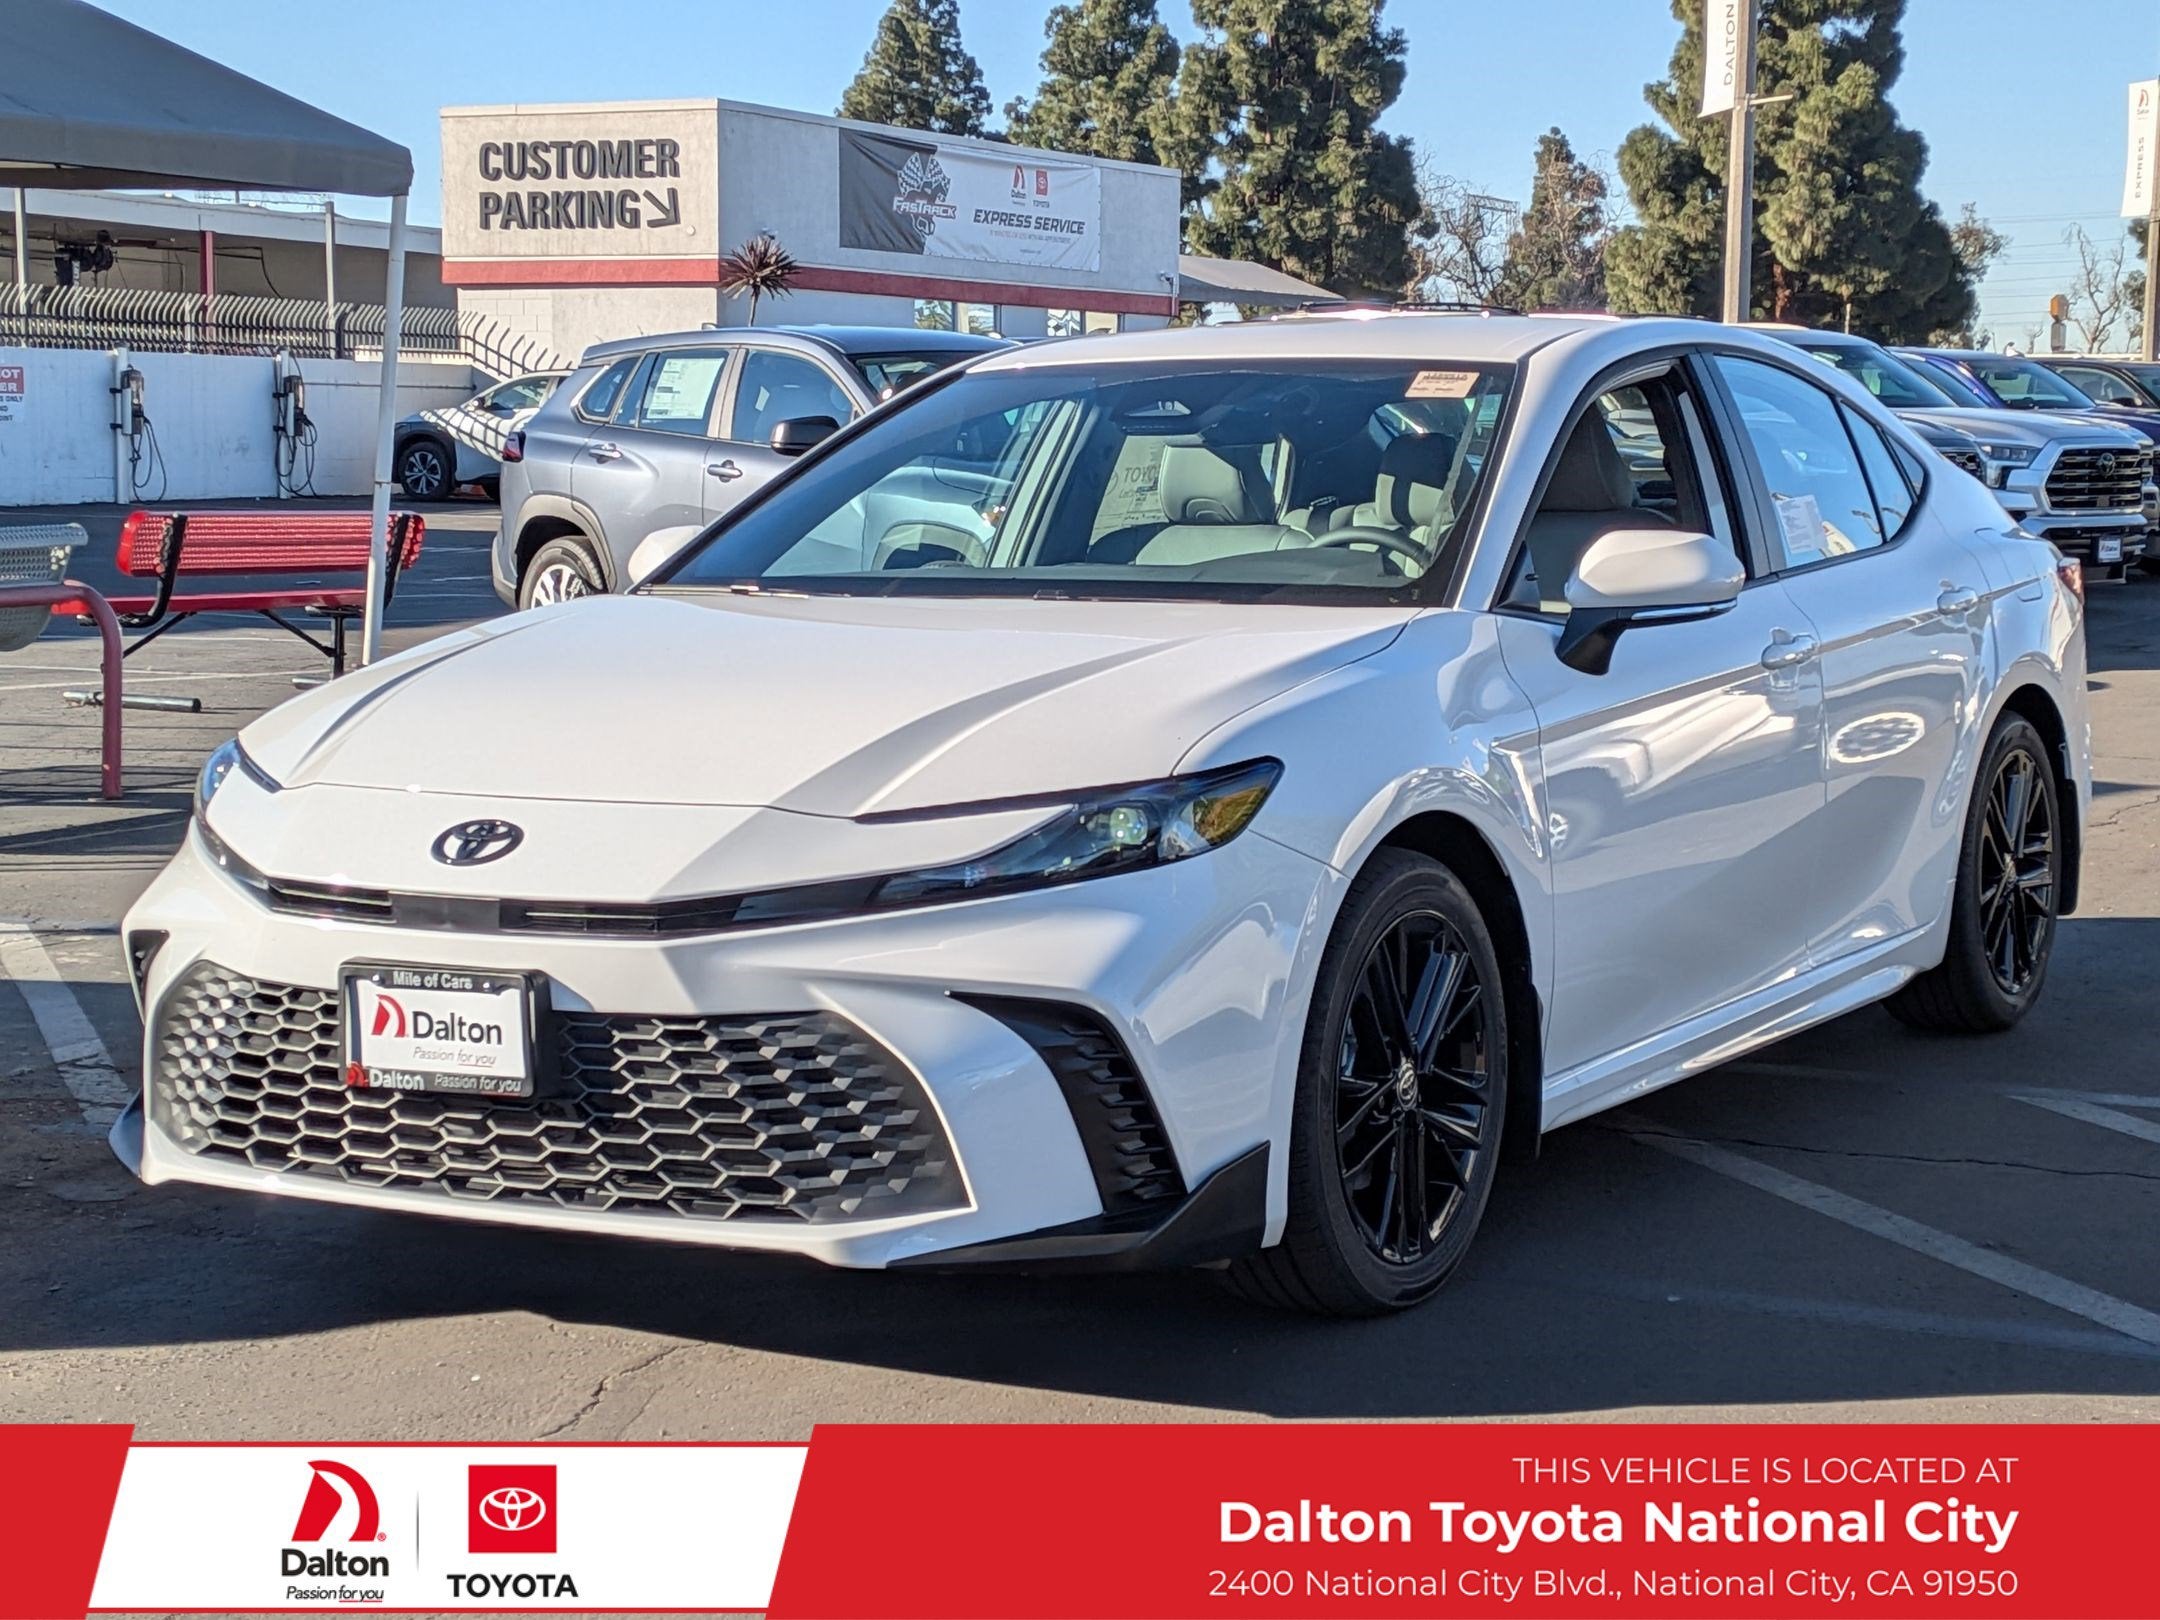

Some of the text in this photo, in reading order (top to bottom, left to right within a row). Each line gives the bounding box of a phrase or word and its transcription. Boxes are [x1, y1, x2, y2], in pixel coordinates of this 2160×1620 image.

[1723, 3, 1736, 86] DALTON
[479, 138, 681, 182] CUSTOMER
[479, 189, 641, 230] PARKING
[973, 208, 1085, 235] EXPRESS SERVICE
[0, 368, 20, 379] OT
[393, 970, 473, 989] Mile of Cars
[412, 1011, 502, 1045] Dalton
[412, 1046, 496, 1066] Passion for you
[369, 1069, 521, 1093] Dalton Passion for you
